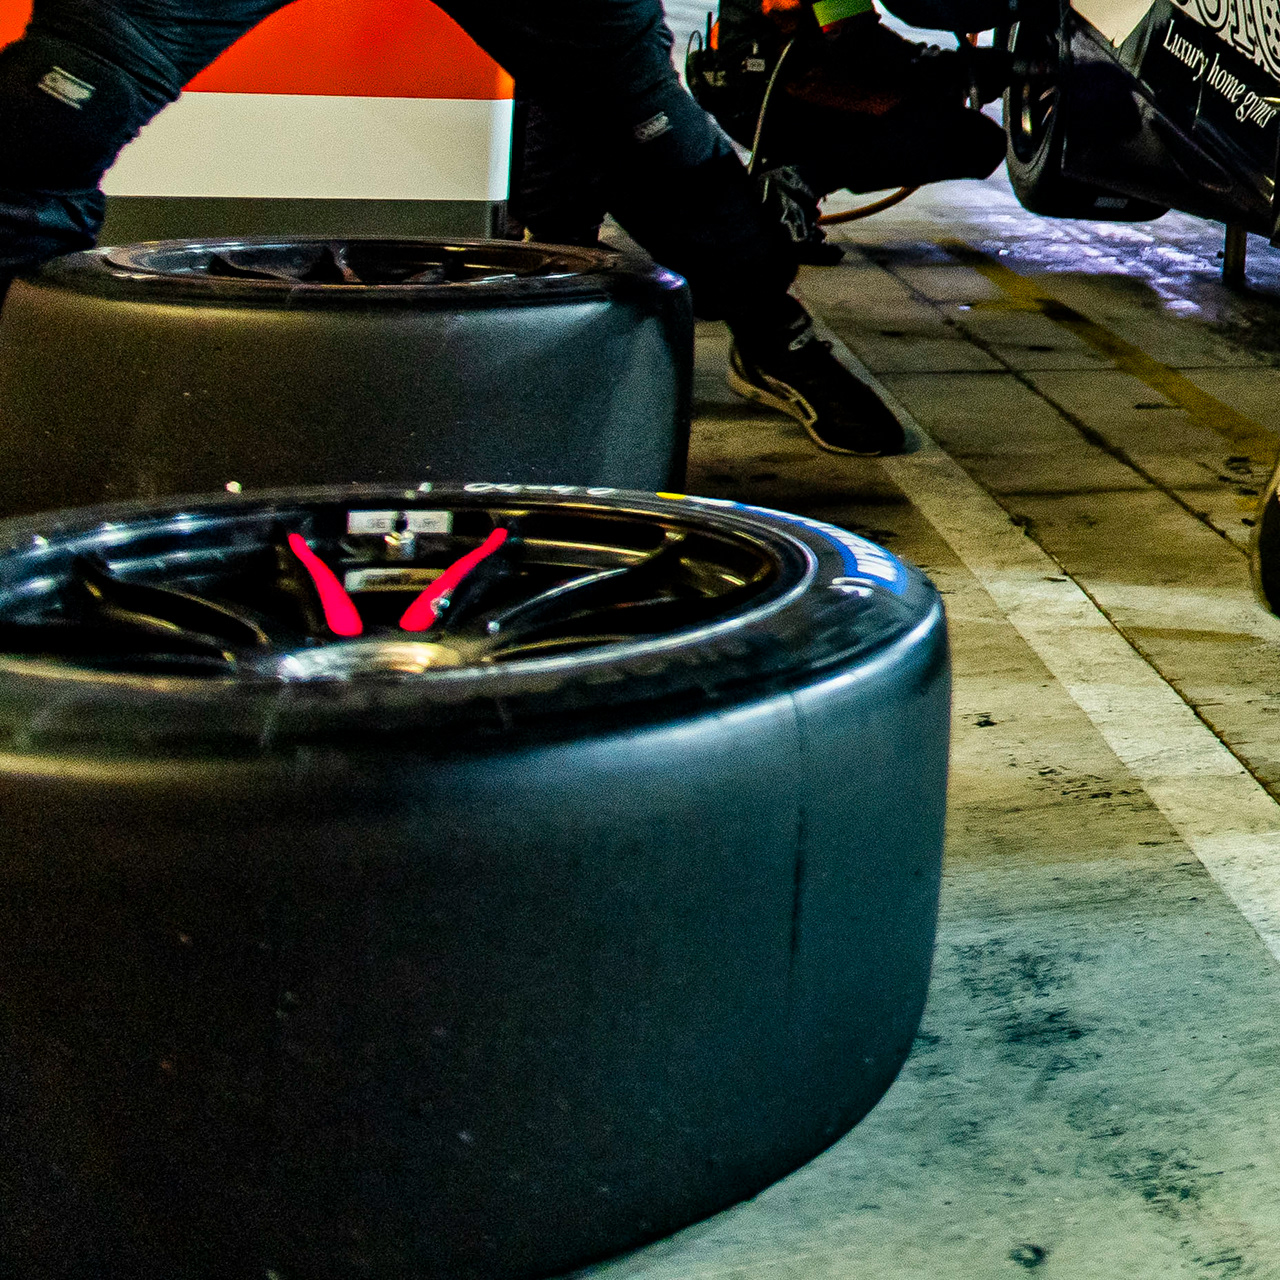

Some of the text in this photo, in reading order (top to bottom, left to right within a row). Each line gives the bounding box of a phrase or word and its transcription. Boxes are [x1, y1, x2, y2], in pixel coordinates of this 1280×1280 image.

[1162, 19, 1278, 129] Luxury home gyms
